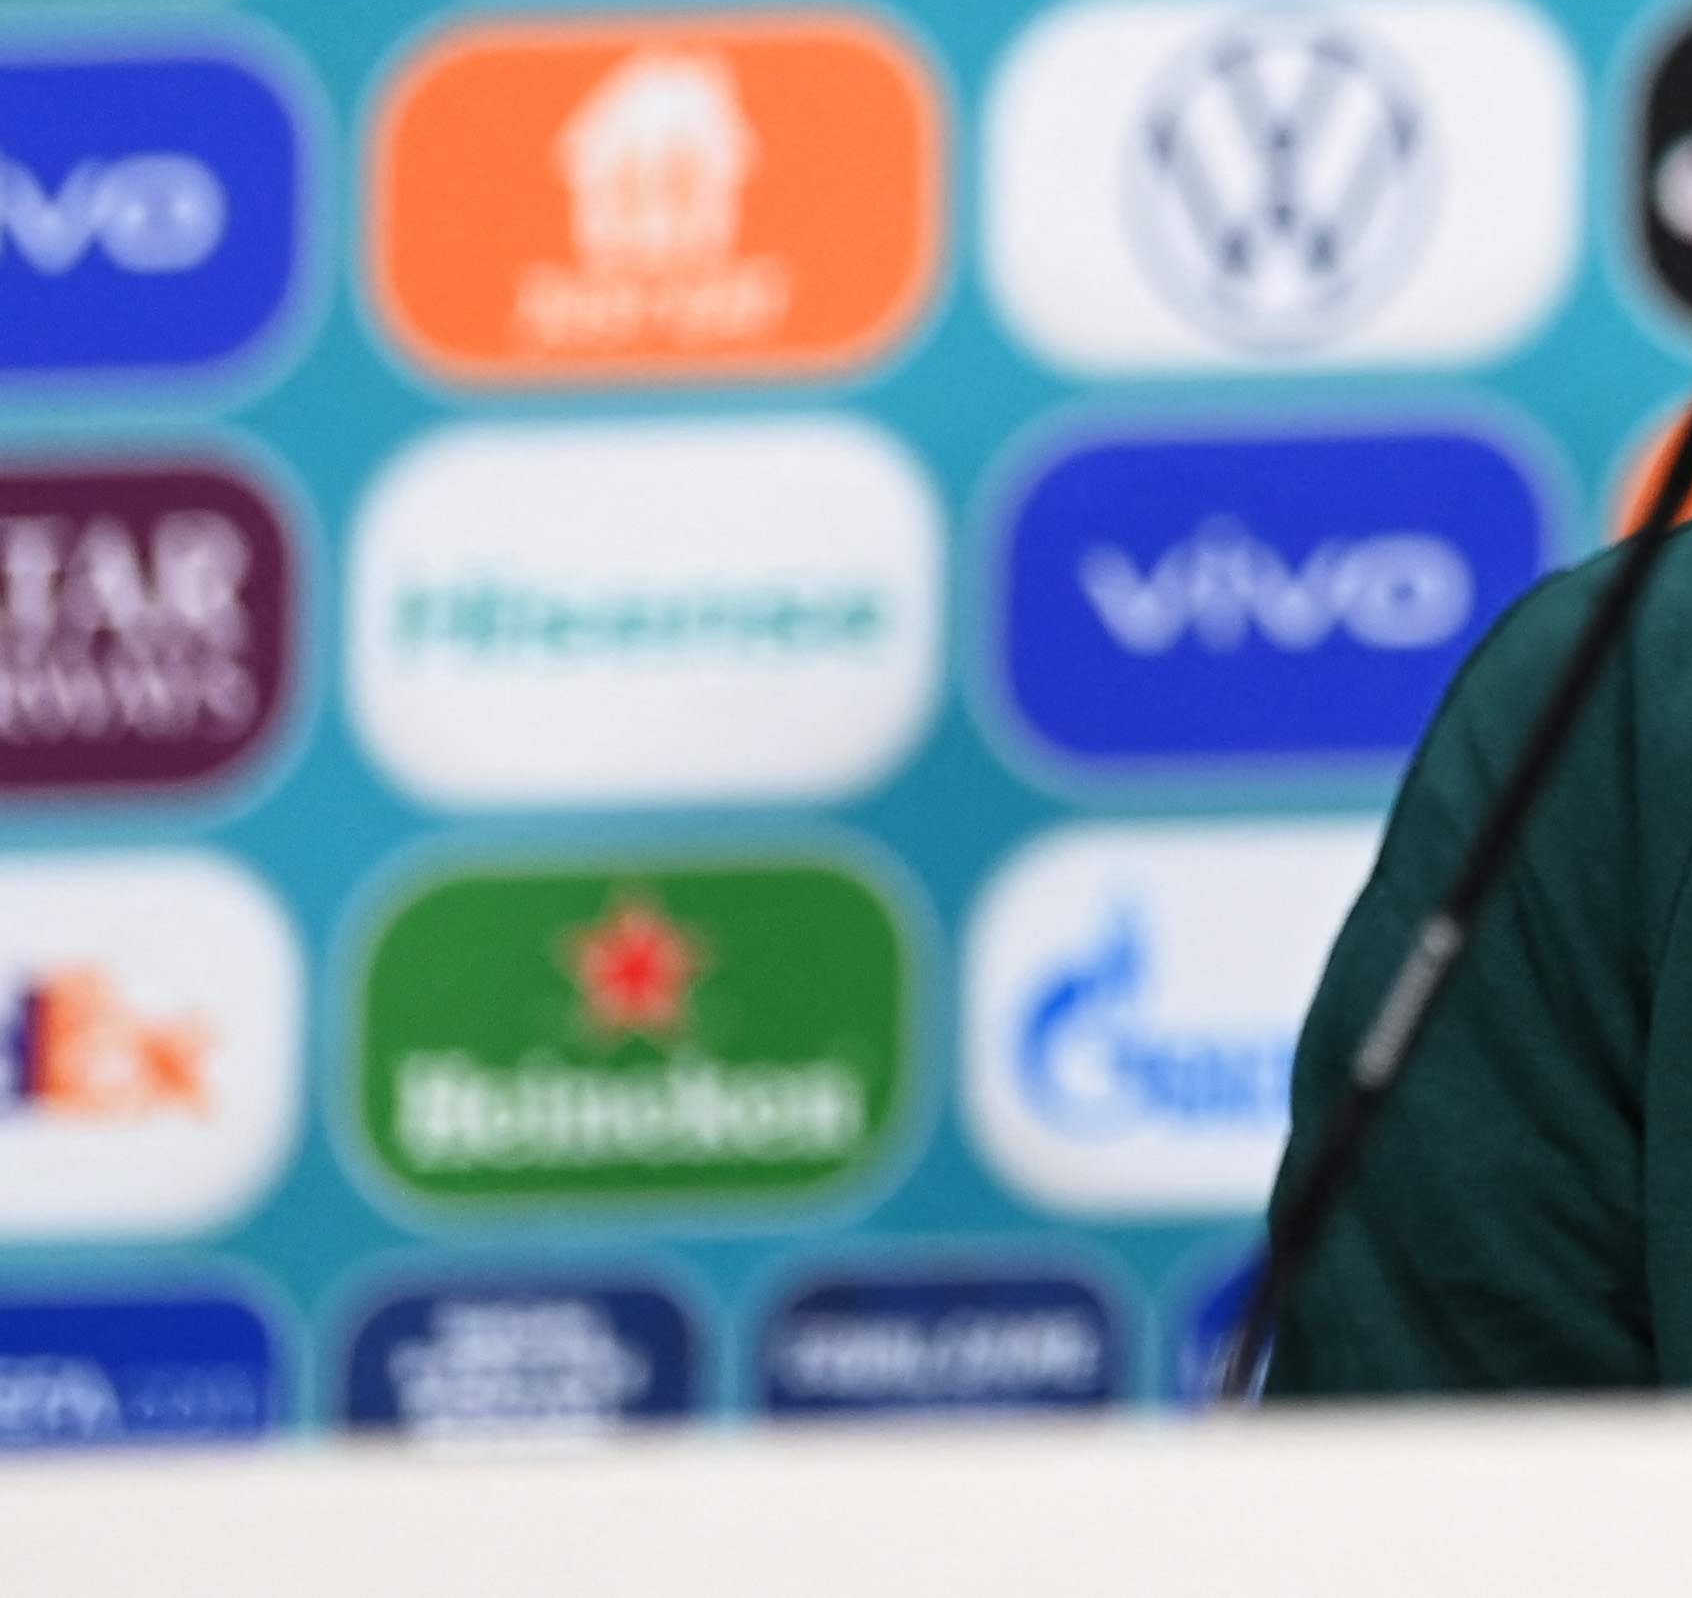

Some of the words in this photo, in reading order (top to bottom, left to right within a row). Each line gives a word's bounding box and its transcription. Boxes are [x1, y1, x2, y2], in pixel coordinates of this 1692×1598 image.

[0, 508, 252, 627] TAR
[1079, 516, 1475, 654] vivo
[394, 1047, 863, 1174] Heineken
